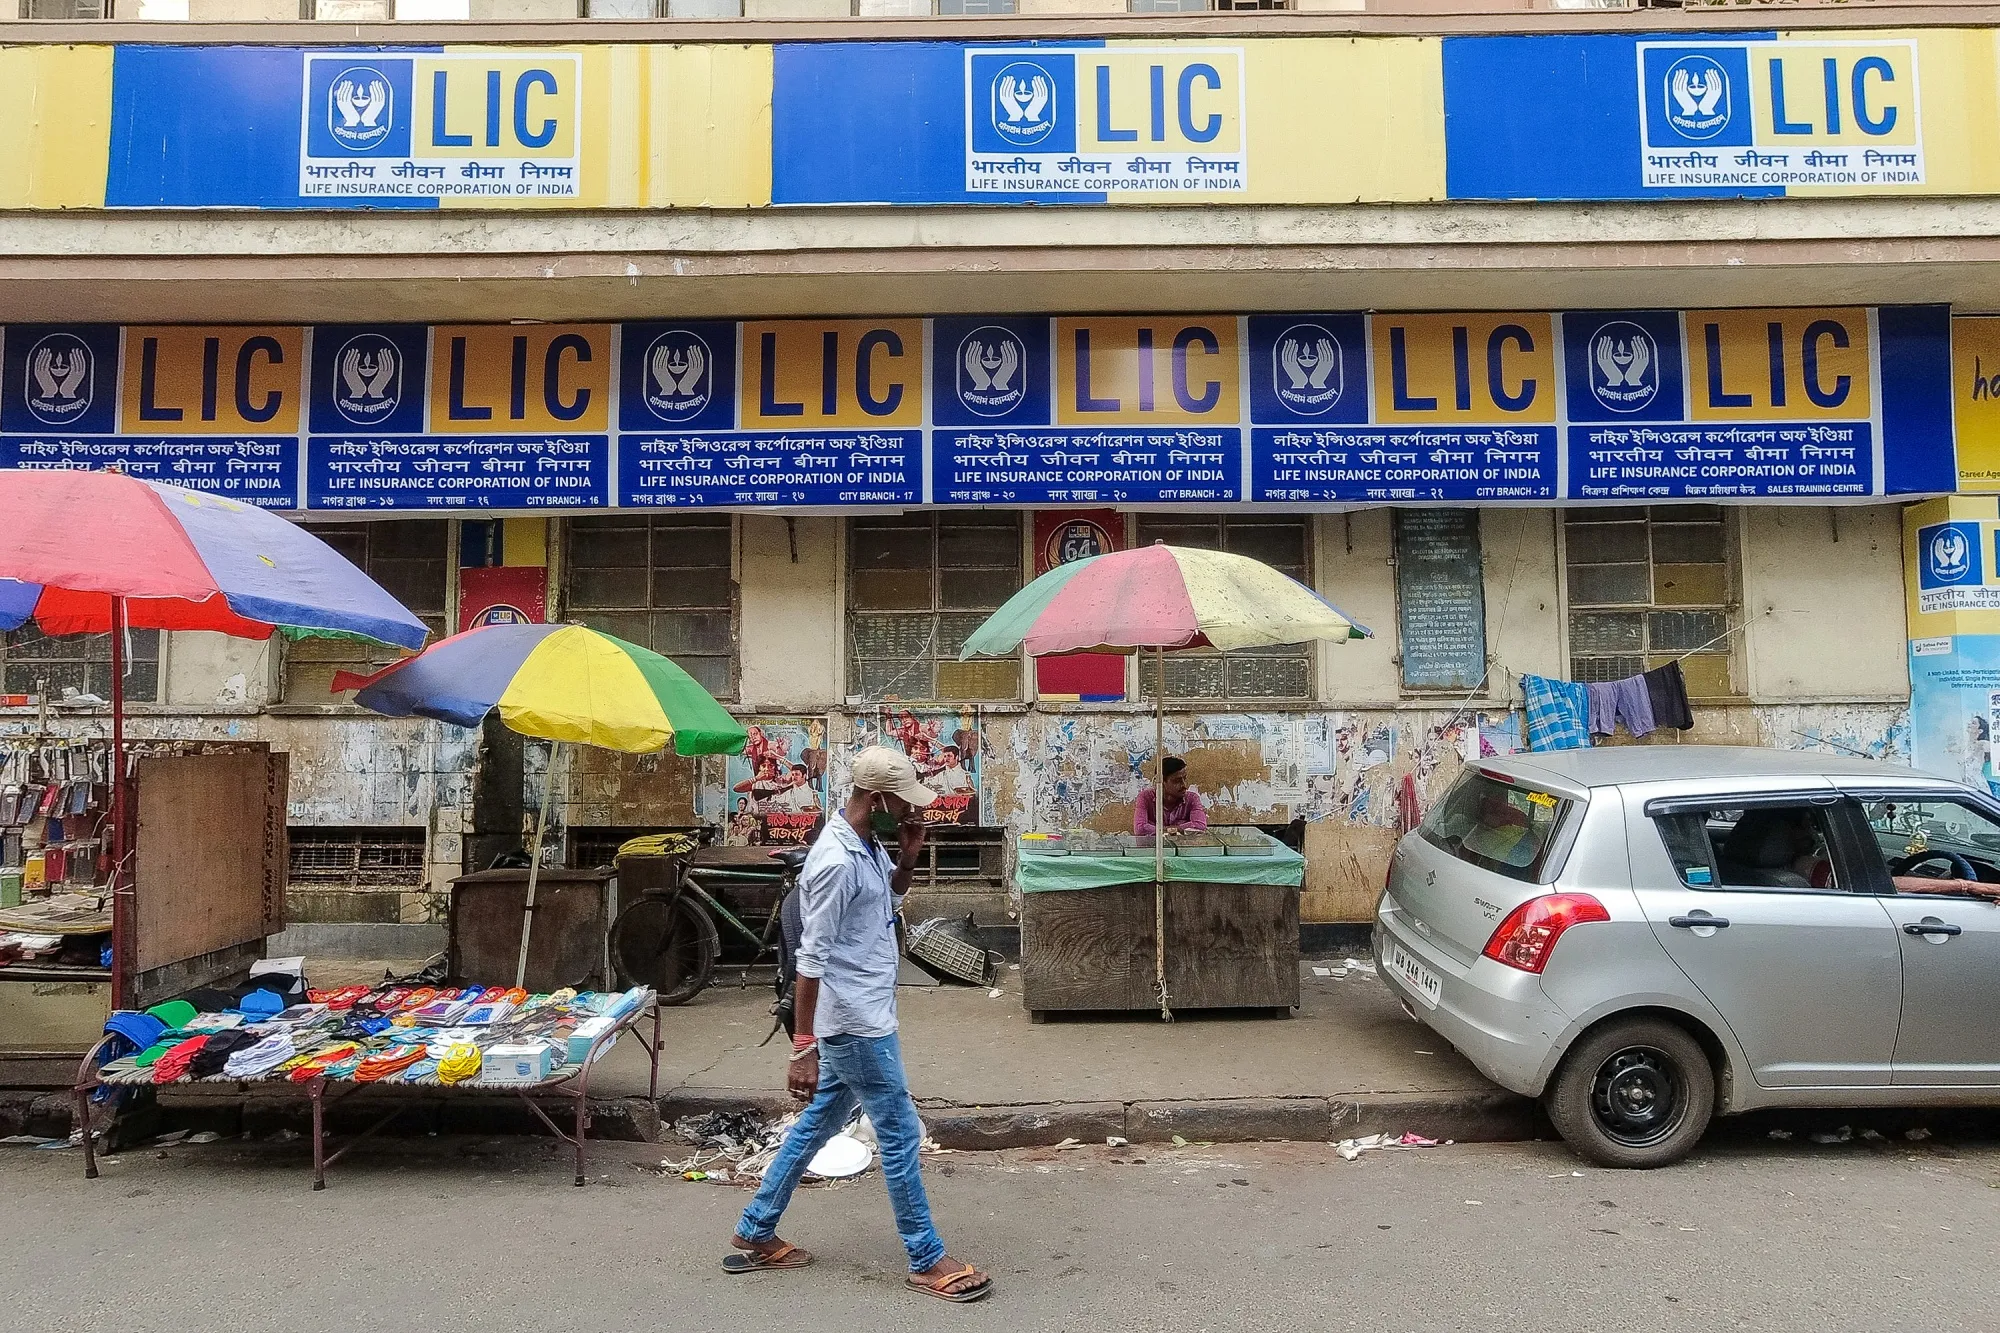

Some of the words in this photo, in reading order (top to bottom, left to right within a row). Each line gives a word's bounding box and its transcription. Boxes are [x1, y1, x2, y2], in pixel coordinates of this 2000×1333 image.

[1096, 63, 1222, 142] LIC
[1769, 56, 1897, 135] LIC
[432, 70, 557, 148] LIC
[972, 158, 1042, 174] भारतीय
[1058, 157, 1111, 174] जीवन
[1127, 157, 1171, 174] बीमा
[1187, 157, 1240, 173] निगम
[1648, 151, 1718, 168] भारतीय
[1735, 151, 1788, 167] जीवन
[1804, 150, 1847, 167] बीमा
[1863, 150, 1916, 166] निगम
[306, 162, 376, 178] भारतीय
[392, 162, 445, 178] जीवन
[460, 162, 504, 179] बीमा
[520, 162, 572, 179] निगम
[1649, 173, 1674, 184] LIFE
[1680, 173, 1757, 183] INSURANCE
[1762, 172, 1855, 183] CORPORATION
[1861, 172, 1877, 182] OF
[1883, 172, 1919, 182] INDIA
[305, 183, 332, 194] LIFE
[337, 184, 412, 194] INSURANCE
[417, 184, 508, 194] CORPORATION
[516, 184, 533, 194] OF
[538, 184, 573, 194] INDIA
[972, 179, 998, 189] LIFE
[1004, 179, 1079, 189] INSURANCE
[1085, 179, 1176, 189] CORPORATION
[1183, 179, 1199, 188] OF
[1205, 179, 1241, 188] INDIA
[1074, 325, 1220, 414] LIC
[1391, 326, 1536, 413] LIC
[1704, 319, 1850, 408] LIC
[138, 333, 284, 423] LIC
[448, 332, 592, 422] LIC
[760, 329, 904, 416] LIC
[955, 434, 993, 451] লাইফ
[1148, 436, 1174, 447] অফ
[1273, 433, 1312, 449] লাইফ
[1465, 435, 1491, 446] অফ
[1590, 430, 1628, 446] লাইফ
[1780, 431, 1806, 443] অফ
[20, 441, 58, 456] লাইফ
[208, 444, 233, 455] অফ
[330, 441, 368, 456] লাইফ
[518, 443, 544, 455] অফ
[640, 439, 679, 455] লাইফ
[829, 439, 855, 450] অফ
[1590, 447, 1663, 462] भारतीय
[1675, 446, 1733, 461] जीवन
[1744, 446, 1789, 460] बीमा
[1800, 446, 1855, 460] निगम
[639, 457, 712, 471] भारतीय
[724, 456, 782, 470] जीवन
[793, 454, 837, 469] बीमा
[849, 453, 904, 467] निगम
[954, 452, 1028, 466] भारतीय
[1041, 451, 1099, 465] जीवन
[1111, 450, 1156, 465] बीमा
[1168, 450, 1224, 464] निगम
[1273, 450, 1347, 465] भारतीय
[1359, 450, 1417, 464] जीवन
[1429, 449, 1473, 464] बीमा
[1484, 448, 1540, 463] निगम
[172, 459, 216, 473] बीमा
[227, 459, 281, 473] निगम
[328, 459, 401, 473] भारतीय
[413, 459, 470, 473] जीवन
[482, 458, 525, 472] बीमा
[537, 458, 591, 472] निगम
[1590, 468, 1617, 478] LIFE
[1622, 467, 1696, 478] INSURANCE
[1701, 466, 1794, 476] CORPORATION
[1800, 466, 1816, 475] OF
[1820, 464, 1856, 475] INDIA
[640, 476, 666, 487] LIFE
[671, 475, 746, 486] INSURANCE
[750, 474, 843, 485] CORPORATION
[847, 473, 863, 483] OF
[869, 472, 905, 483] INDIA
[954, 471, 982, 482] LIFE
[986, 471, 1063, 482] INSURANCE
[1067, 471, 1161, 481] CORPORATION
[1166, 471, 1183, 481] OF
[1188, 470, 1224, 481] INDIA
[1274, 470, 1300, 481] LIFE
[1305, 470, 1381, 481] INSURANCE
[1385, 469, 1478, 480] CORPORATION
[1483, 469, 1499, 479] OF
[1504, 468, 1540, 479] INDIA
[224, 478, 240, 489] OF
[245, 478, 280, 489] INDIA
[329, 478, 355, 488] LIFE
[360, 478, 434, 488] INSURANCE
[438, 478, 530, 488] CORPORATION
[535, 478, 551, 487] OF
[555, 477, 591, 487] INDIA
[1833, 484, 1864, 492] CENTRE
[840, 492, 858, 501] CITY
[860, 492, 894, 501] BRANCH
[904, 492, 912, 500] 17
[1159, 490, 1178, 499] CITY
[1180, 490, 1214, 498] BRANCH
[1223, 489, 1232, 498] 20
[1265, 490, 1286, 499] নগর
[1367, 489, 1387, 498] नगर
[1477, 488, 1495, 497] CITY
[1497, 487, 1531, 496] BRANCH
[1540, 487, 1549, 496] 21
[257, 497, 290, 506] BRANCH
[547, 497, 581, 505] BRANCH
[1921, 588, 1965, 602] भारतीय
[1921, 603, 1937, 612] LIFE
[1940, 600, 1986, 609] INSURANCE
[264, 804, 274, 859] ASSAM
[263, 868, 273, 924] ASSAM
[1421, 971, 1438, 995] 1447
